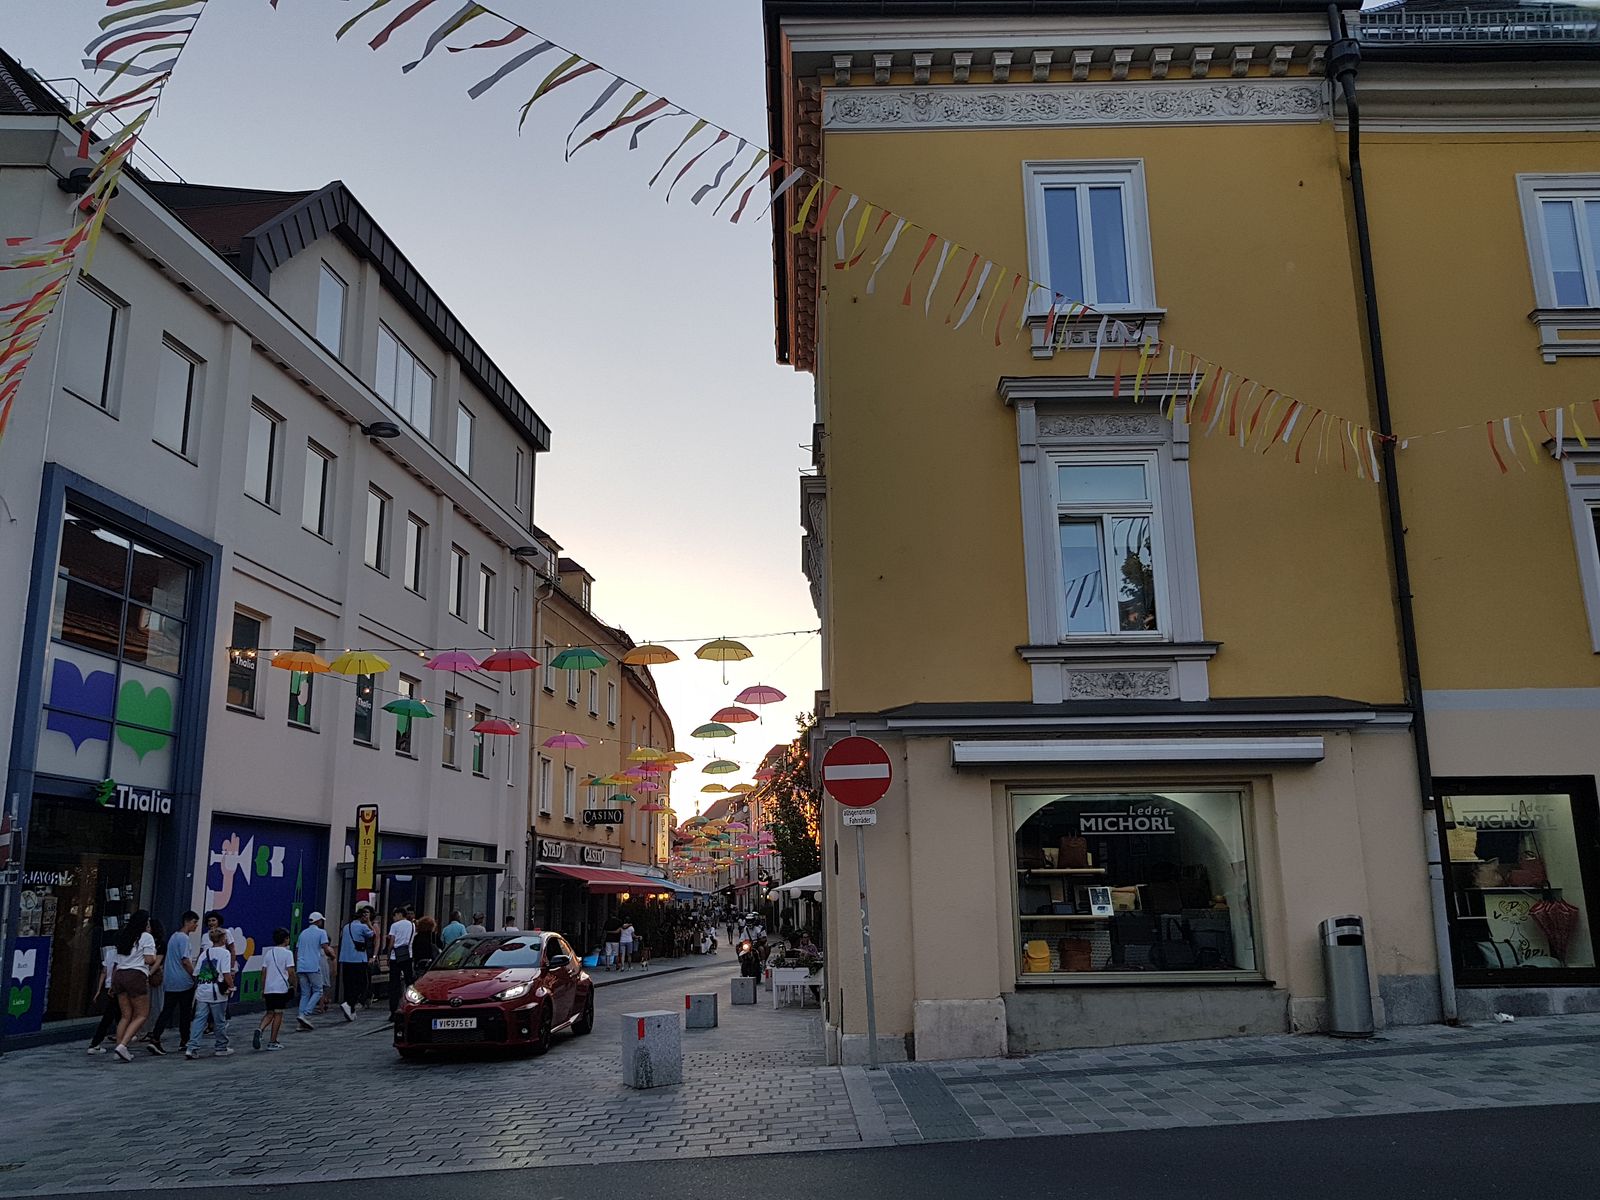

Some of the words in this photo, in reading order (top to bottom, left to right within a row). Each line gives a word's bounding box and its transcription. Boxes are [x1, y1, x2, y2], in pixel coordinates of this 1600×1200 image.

[234, 655, 255, 670] Thalia
[116, 784, 172, 815] Thalia
[584, 810, 622, 824] CASINO
[1079, 816, 1176, 832] MICHORL
[363, 838, 372, 846] 10
[584, 847, 606, 864] CASINO
